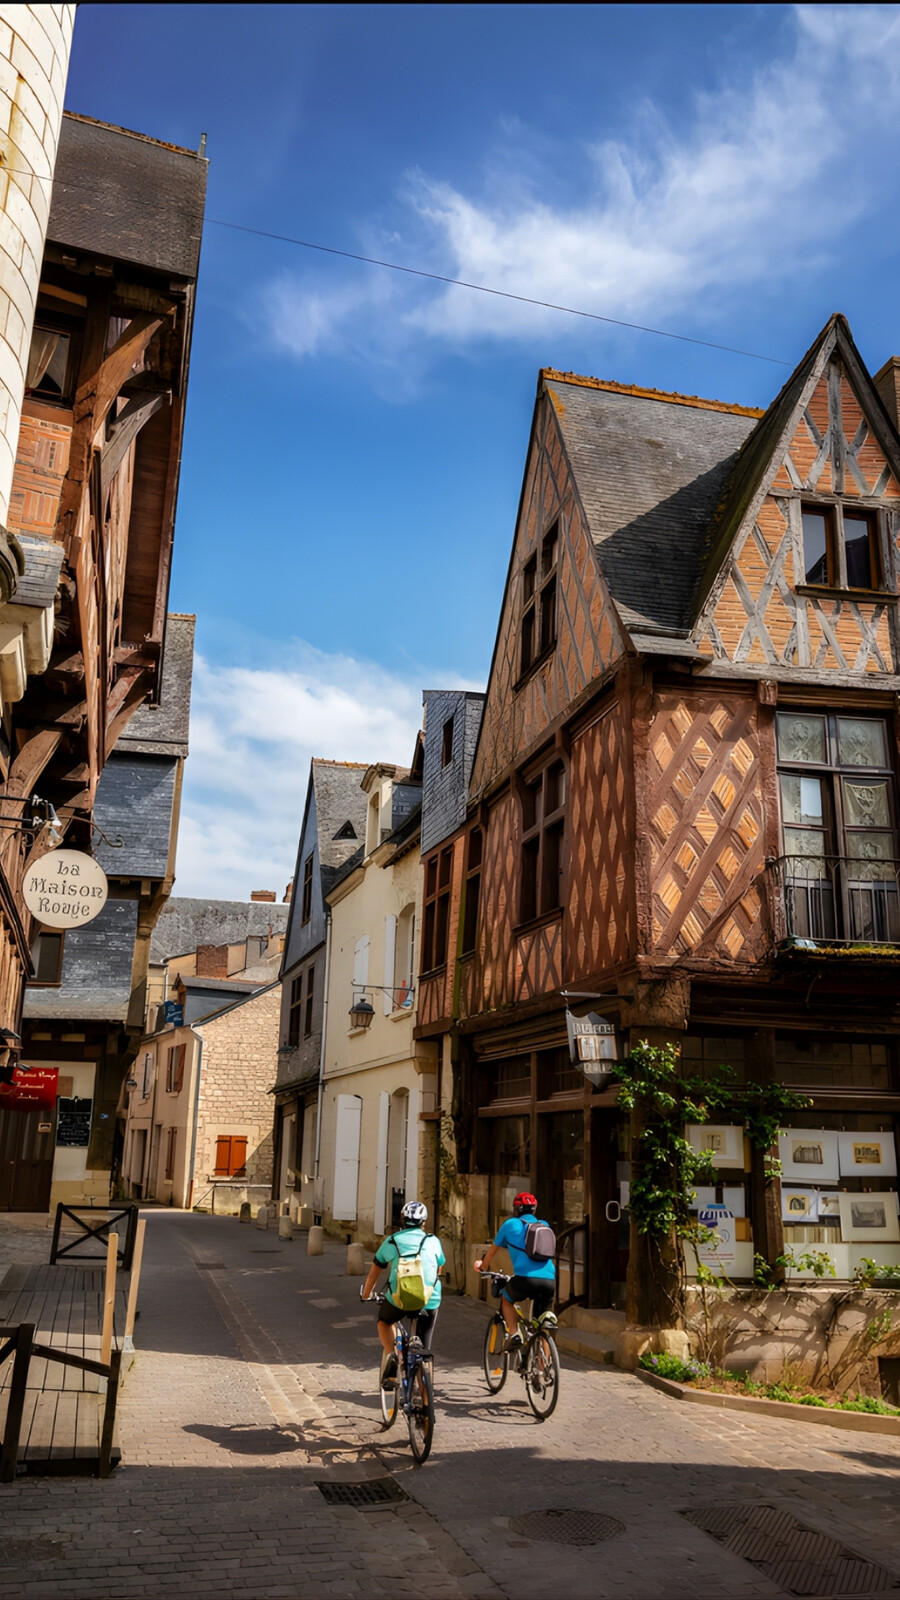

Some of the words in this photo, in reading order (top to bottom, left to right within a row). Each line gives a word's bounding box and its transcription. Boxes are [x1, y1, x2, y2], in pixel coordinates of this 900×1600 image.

[57, 860, 80, 876] La
[29, 877, 103, 899] Maison
[38, 897, 90, 919] Rouge
